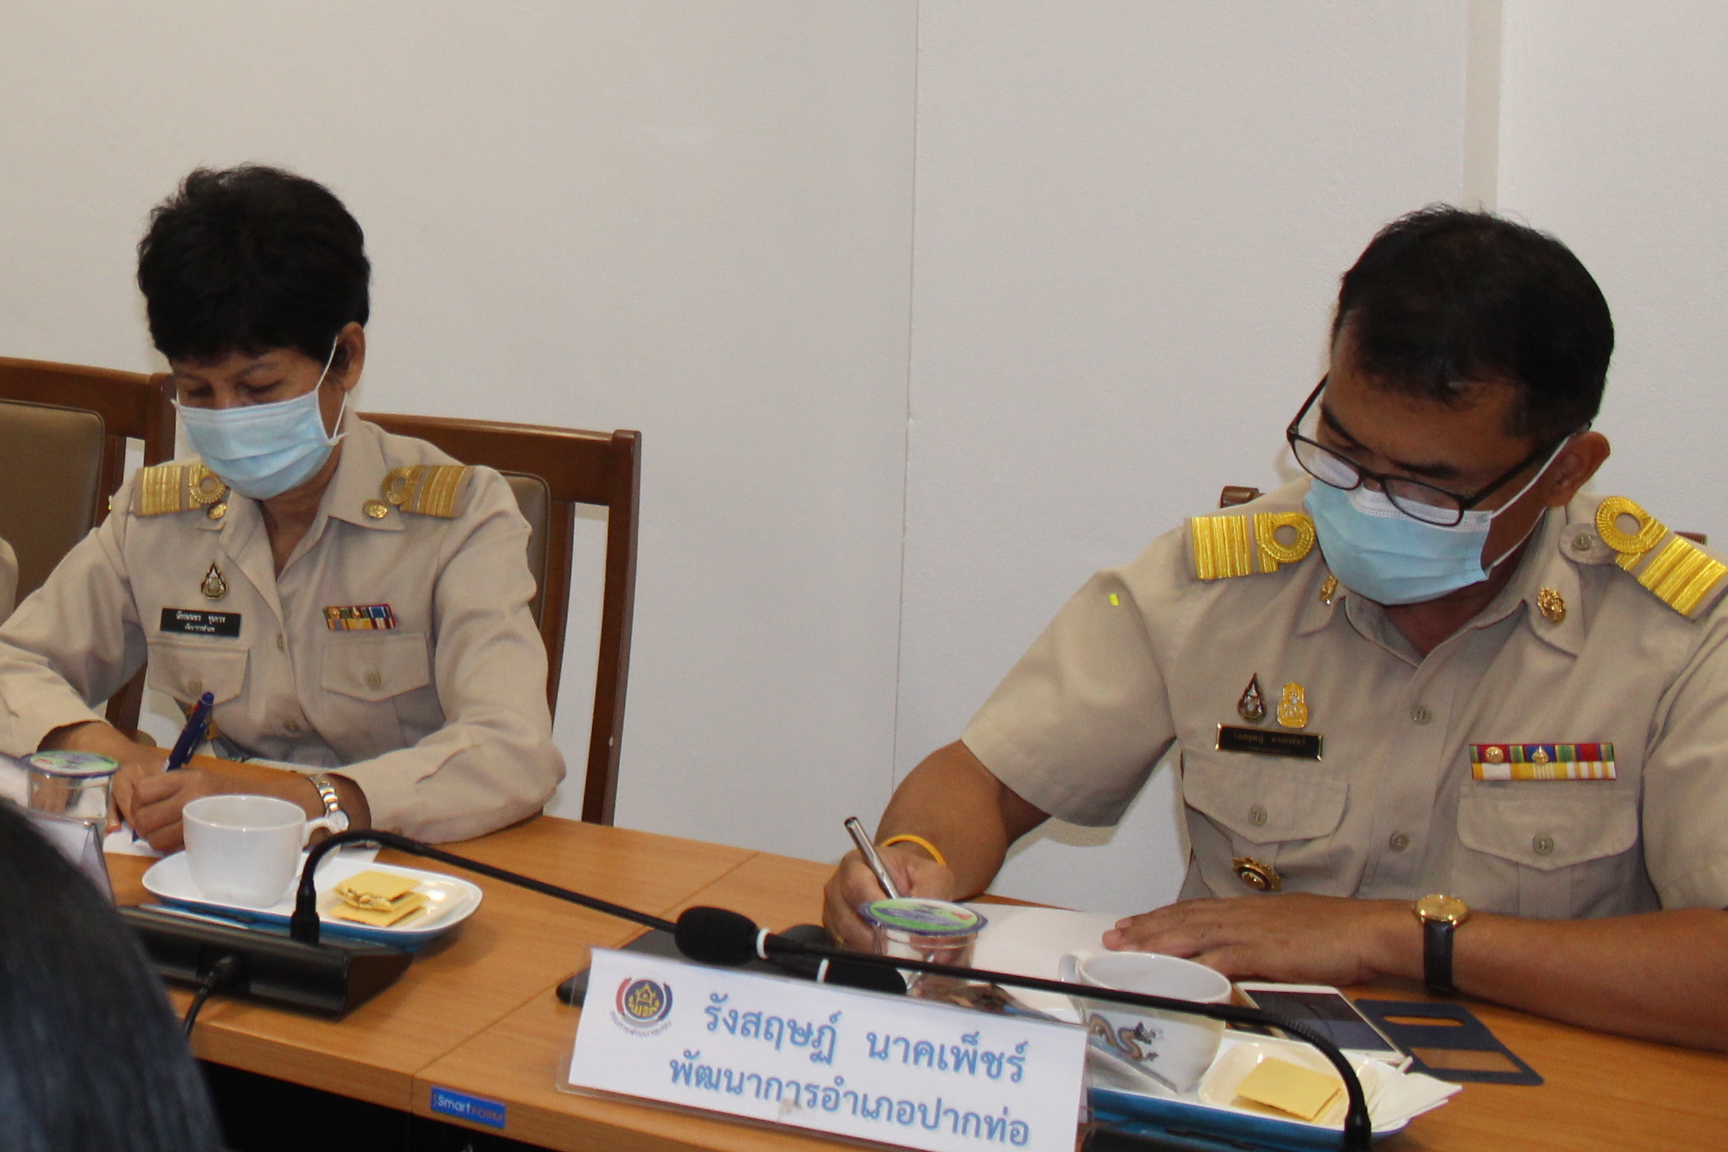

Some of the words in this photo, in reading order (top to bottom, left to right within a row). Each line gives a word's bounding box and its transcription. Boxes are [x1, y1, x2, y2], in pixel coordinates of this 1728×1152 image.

[867, 1031, 1029, 1084] นาคเพ็ชร์
[670, 1049, 1031, 1148] พัฒนาการอำเภอปากท่อ
